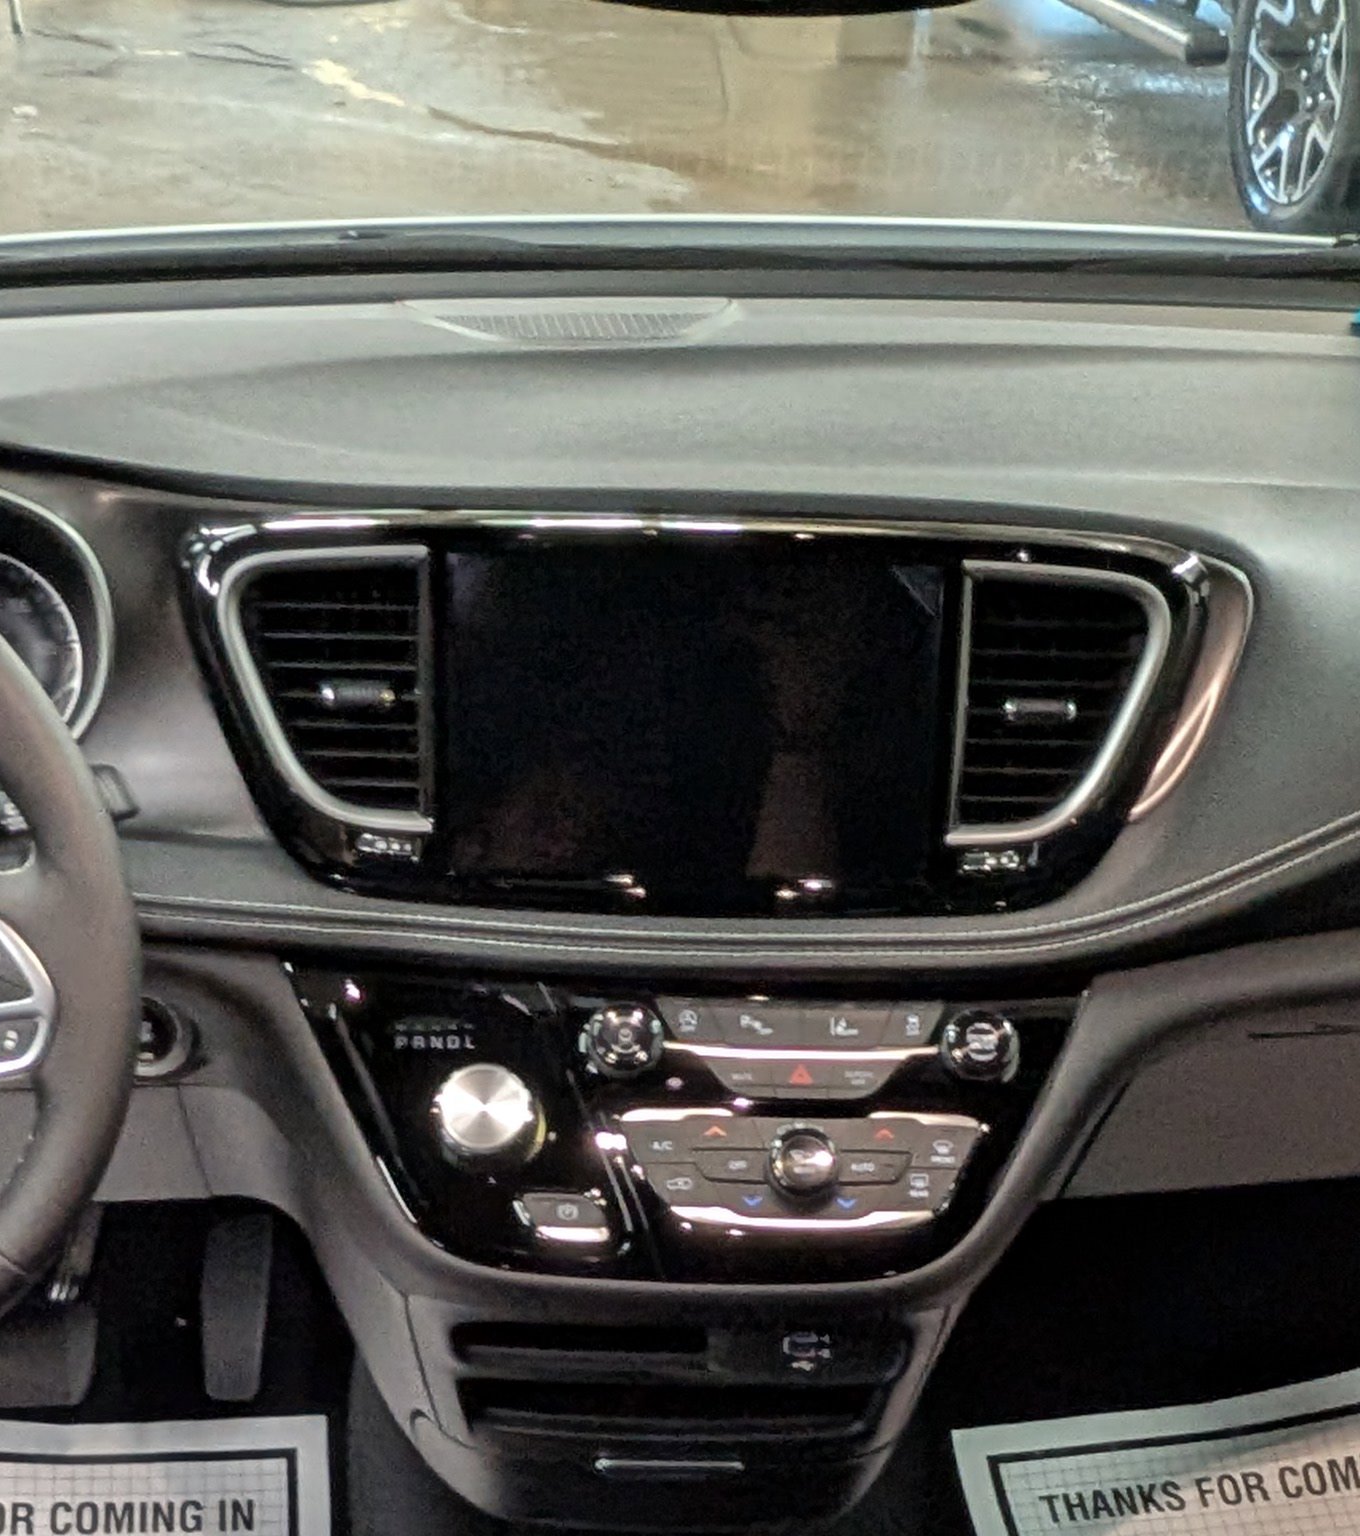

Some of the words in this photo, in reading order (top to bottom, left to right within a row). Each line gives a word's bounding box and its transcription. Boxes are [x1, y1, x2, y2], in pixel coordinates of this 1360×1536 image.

[49, 1499, 205, 1535] COMING
[218, 1498, 255, 1532] IN
[1038, 1480, 1186, 1523] THANKS
[1194, 1471, 1271, 1508] FOR
